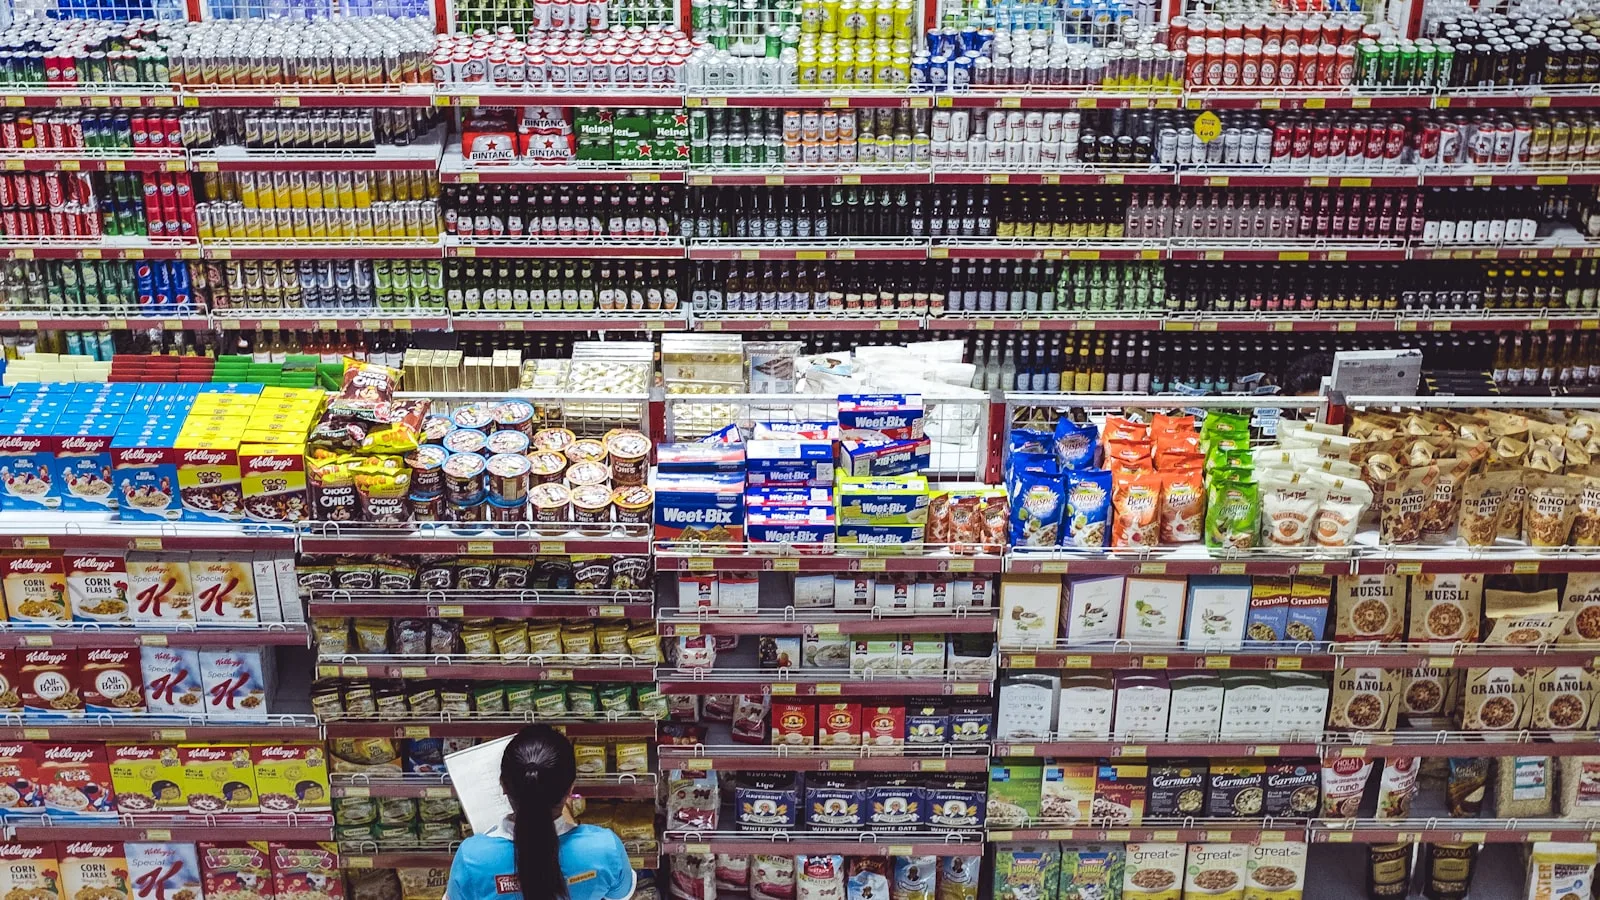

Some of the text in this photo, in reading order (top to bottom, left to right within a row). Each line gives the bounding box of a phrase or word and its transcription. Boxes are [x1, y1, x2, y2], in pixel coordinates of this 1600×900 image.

[525, 119, 564, 128] BINTANG
[472, 150, 512, 160] BINTANG
[530, 149, 569, 157] BINTANG
[352, 375, 388, 391] CHIPS
[860, 398, 899, 406] Weet-Bix
[855, 416, 906, 428] Weet-Bix
[771, 423, 822, 432] Weet-Bix
[62, 438, 104, 450] Kellogg's
[120, 449, 163, 462] Kellogg's
[184, 450, 227, 463] Kellogg's
[249, 457, 293, 469] Kellogg's
[770, 470, 809, 480] Weet-Bix
[322, 487, 352, 495] CHOCO
[863, 482, 903, 490] Weet-Bix
[320, 493, 355, 506] CHIPS
[769, 493, 809, 501] Weet-Bix
[1127, 495, 1152, 506] Berry
[368, 503, 403, 516] CHIPS
[862, 502, 907, 513] Weet-Bix
[1401, 504, 1423, 512] BITES
[1538, 504, 1563, 513] BITES
[663, 508, 733, 522] Weet-Bix
[765, 530, 818, 542] Weet-Bix
[857, 533, 903, 543] Weet-Bix
[10, 559, 52, 572] Kellogg's
[73, 558, 115, 570] Kellogg's
[23, 579, 45, 587] CORN
[84, 577, 110, 586] CORN
[132, 575, 160, 583] Special
[195, 574, 224, 582] Special
[24, 585, 46, 593] FLAKES
[87, 585, 112, 594] FLAKES
[1350, 586, 1393, 597] MUESLI
[136, 578, 176, 617] K
[199, 577, 239, 616] K
[1425, 589, 1469, 600] MUESLI
[1569, 593, 1600, 602] GRAN
[1251, 596, 1288, 606] Granola
[1290, 596, 1328, 606] Granola
[1253, 614, 1279, 622] Blueberry
[1292, 612, 1318, 621] Blueberry
[26, 652, 66, 664] Kellogg's
[88, 650, 129, 662] Kellogg's
[154, 652, 183, 662] Kellogg's
[216, 658, 244, 666] Kellogg's
[148, 665, 174, 673] Special
[39, 684, 64, 693] Bran
[101, 681, 125, 690] Bran
[151, 670, 187, 705] K
[1339, 680, 1393, 691] GRANOLA
[1471, 683, 1526, 694] GRANOLA
[1539, 682, 1593, 691] GRANOLA
[210, 673, 250, 710] K
[45, 748, 95, 761] Kellogg's
[116, 747, 154, 757] Kellogg's
[188, 749, 226, 759] Kellogg's
[261, 747, 300, 757] Kellogg's
[1152, 775, 1203, 788] Carman's
[1212, 774, 1262, 788] Carman's
[1267, 774, 1318, 787] Carman's
[1335, 782, 1359, 791] crunch
[66, 843, 114, 855] Kellogg's
[144, 848, 176, 856] Kellogg's
[1254, 847, 1290, 860] great
[1433, 848, 1471, 858] GRANOLA
[1134, 850, 1170, 863] great
[1196, 851, 1232, 864] great
[132, 858, 165, 867] Special
[10, 866, 36, 874] CORN
[80, 864, 106, 872] CORN
[1012, 865, 1041, 874] JUNGLE
[1078, 864, 1107, 873] JUNGLE
[137, 861, 183, 900] K
